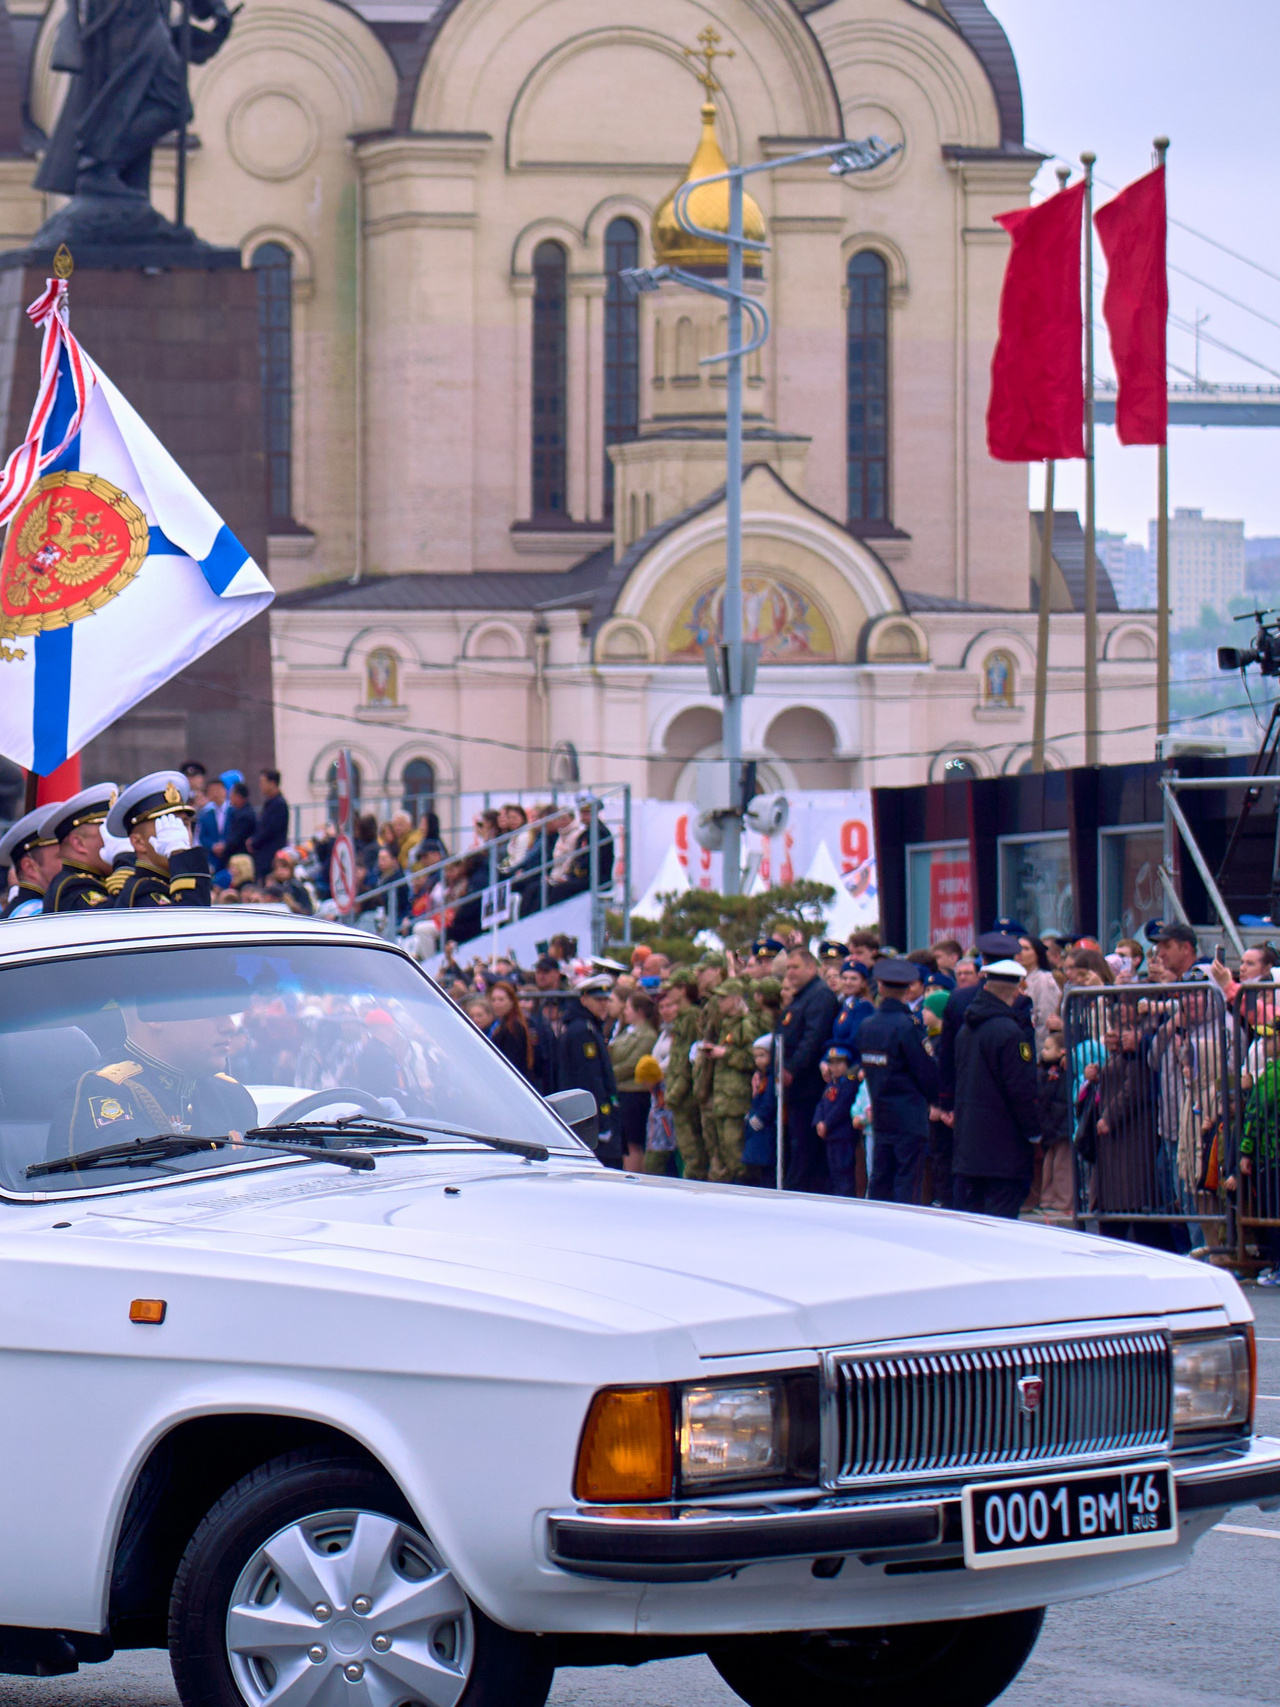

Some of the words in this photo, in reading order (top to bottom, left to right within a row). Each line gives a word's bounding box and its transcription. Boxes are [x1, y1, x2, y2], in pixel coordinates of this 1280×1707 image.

[840, 819, 869, 875] 9
[984, 1487, 1070, 1545] 0001
[1127, 1473, 1160, 1513] 46
[1132, 1513, 1158, 1530] RUS
